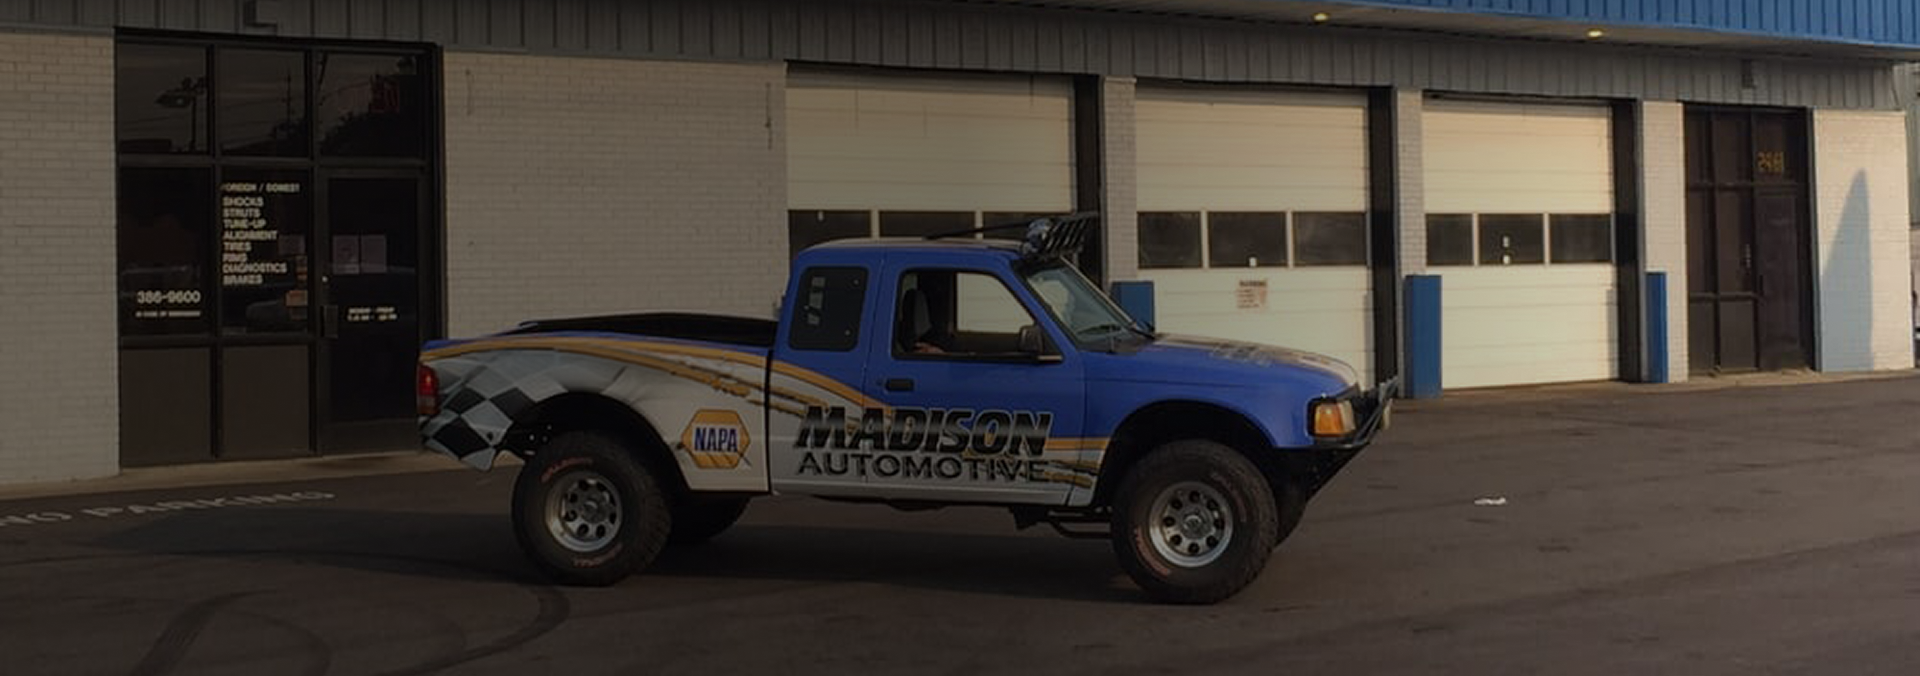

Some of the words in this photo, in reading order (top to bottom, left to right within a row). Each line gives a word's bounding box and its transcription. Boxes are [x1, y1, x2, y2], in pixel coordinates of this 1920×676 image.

[222, 196, 264, 207] SHOCKS
[222, 207, 261, 218] STRUTS
[223, 218, 267, 229] TUNE-UP
[223, 230, 278, 241] ALIGNMENT
[223, 241, 252, 252] TIRES
[222, 262, 287, 274] DIAGNOSTICS
[223, 274, 263, 285] BRAKES
[137, 290, 201, 304] 386-9600
[794, 406, 1053, 457] MADISON
[694, 427, 738, 453] NAPA
[798, 451, 1048, 483] AUTOMOTIVE
[82, 490, 336, 518] PARKING
